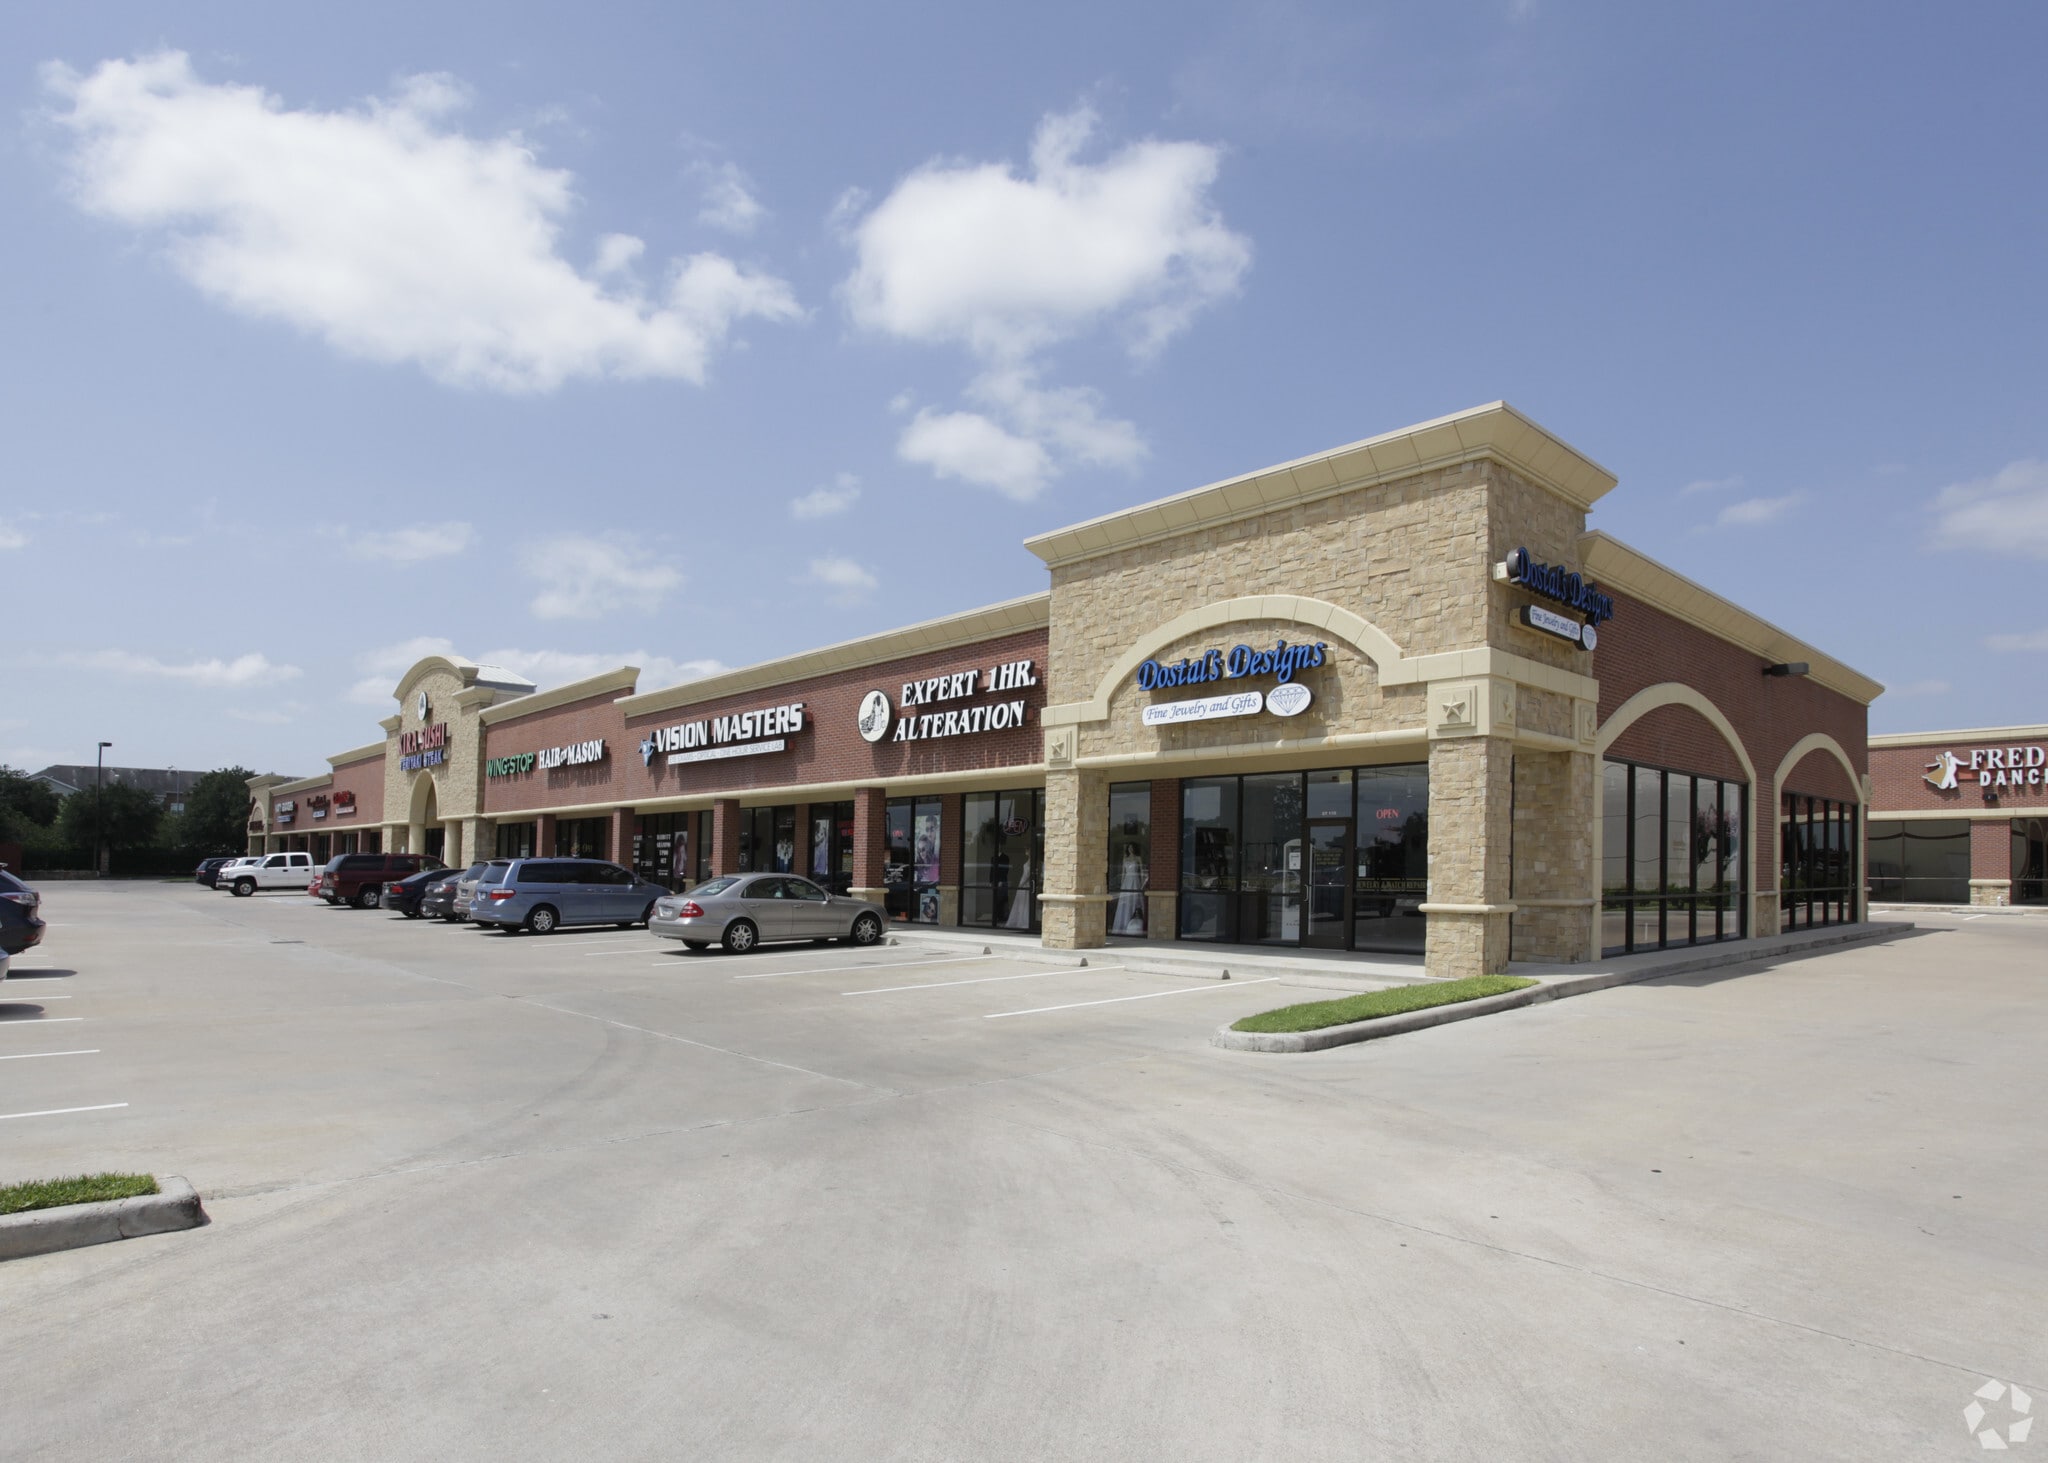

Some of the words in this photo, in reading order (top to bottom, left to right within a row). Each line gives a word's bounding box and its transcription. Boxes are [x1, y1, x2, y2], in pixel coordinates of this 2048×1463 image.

[1518, 546, 1567, 601] Dostal's
[1137, 649, 1223, 691] Dostal's
[1227, 640, 1326, 683] Designs
[901, 669, 978, 707] EXPERT
[986, 660, 1036, 693] 1HR.
[892, 700, 1025, 742] ALTERATION
[1146, 706, 1167, 720] Fine
[1170, 701, 1207, 719] Jewelry
[1210, 700, 1228, 712] and
[1231, 695, 1258, 714] Gifts
[419, 723, 445, 750] SUSHI
[656, 720, 708, 752] VISION
[713, 703, 803, 744] MASTERS
[423, 749, 443, 768] STEAK
[538, 747, 560, 770] HAIR
[567, 738, 603, 765] MASON
[1969, 746, 2045, 770] FRED
[1979, 768, 2048, 787] DANC
[1376, 808, 1399, 819] OPEN
